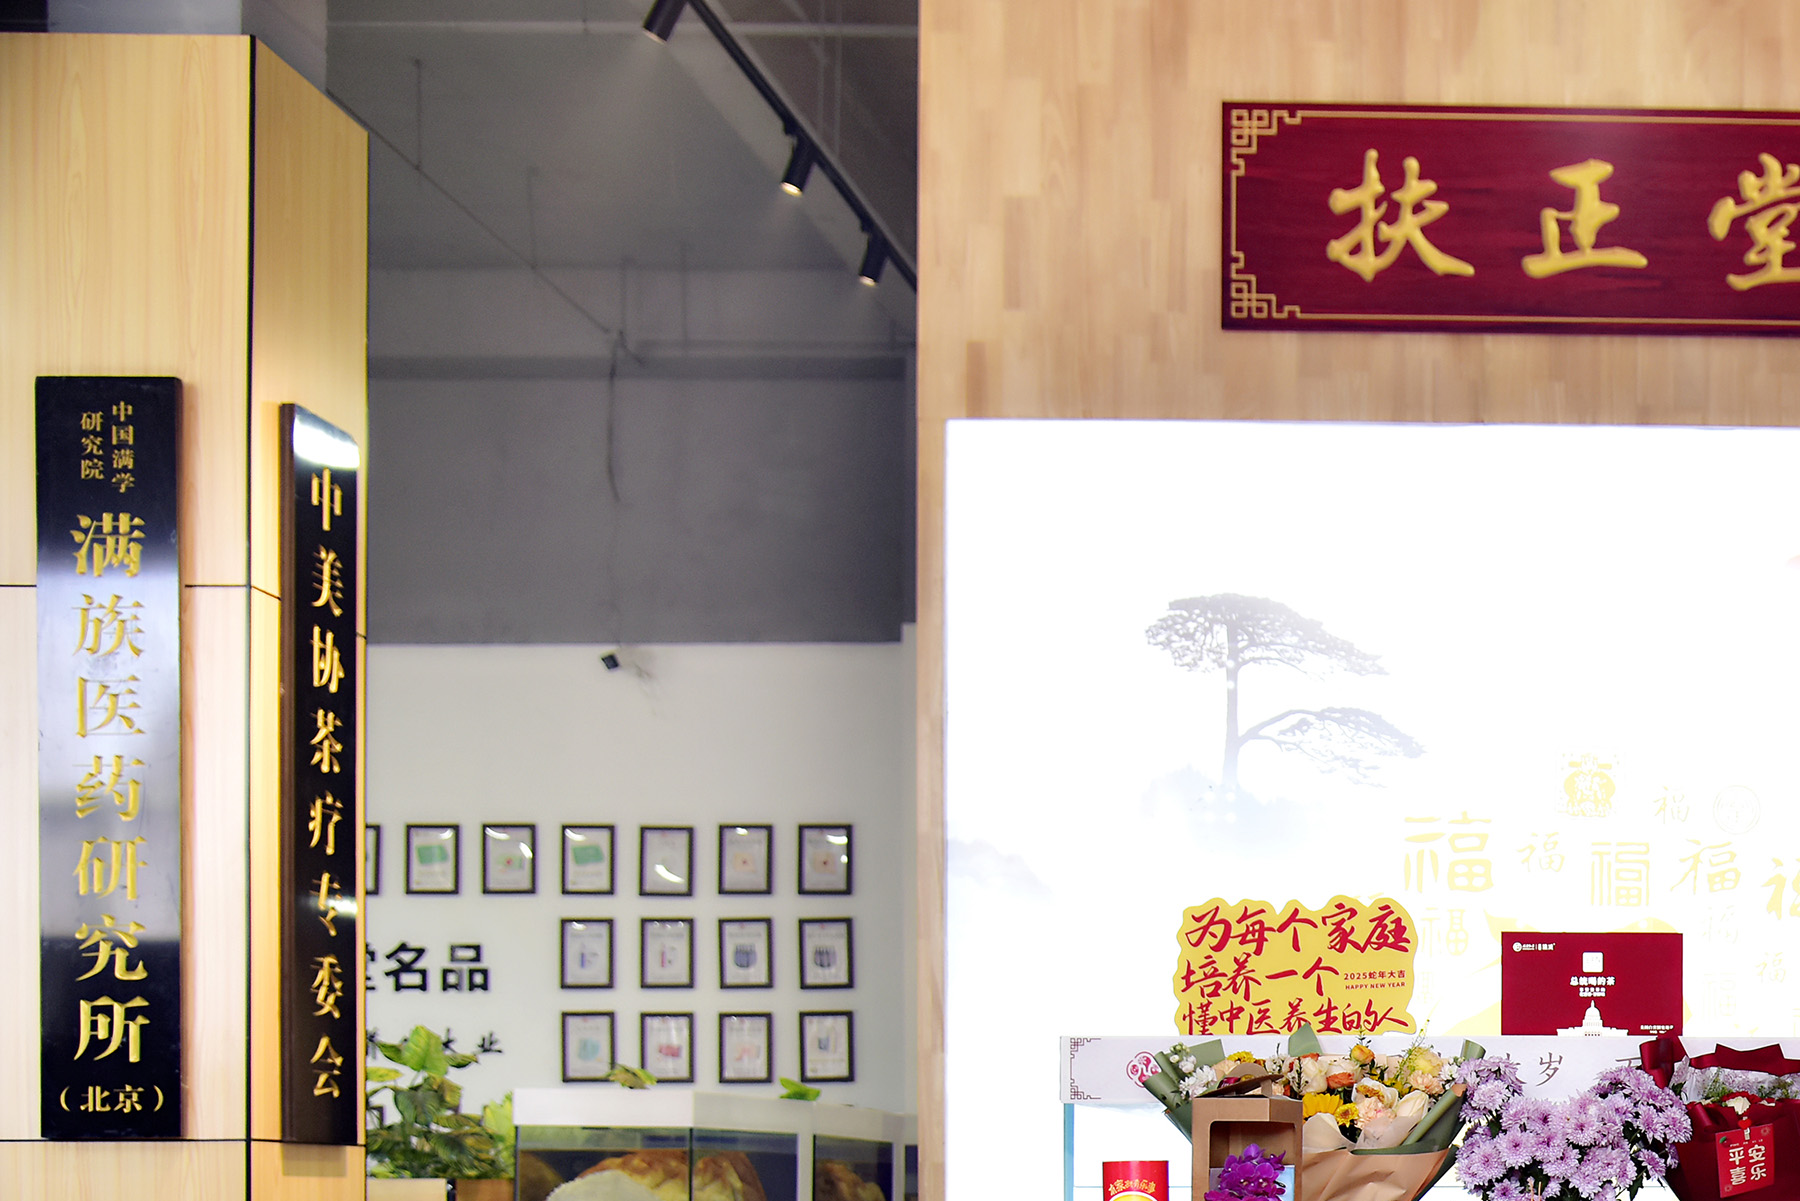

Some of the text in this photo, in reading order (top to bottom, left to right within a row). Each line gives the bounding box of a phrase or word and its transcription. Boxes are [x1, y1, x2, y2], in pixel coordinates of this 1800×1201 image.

[80, 411, 104, 481] 研究院
[111, 401, 135, 493] 中国满学
[70, 511, 150, 1064] 满族医药研究所
[308, 467, 345, 1100] 中美协茶疗专委会
[1403, 810, 1493, 892] 福
[1517, 832, 1567, 873] 福
[1670, 836, 1743, 894] 福
[1185, 902, 1411, 956] 为每个家庭
[1181, 951, 1340, 1001] 培养一个
[1344, 970, 1406, 981] 2025蛇年大吉
[1345, 983, 1369, 991] HAPPY
[1182, 997, 1409, 1035] 懂中医养生的人
[1729, 1144, 1766, 1165] 平安
[1730, 1163, 1767, 1185] 喜乐
